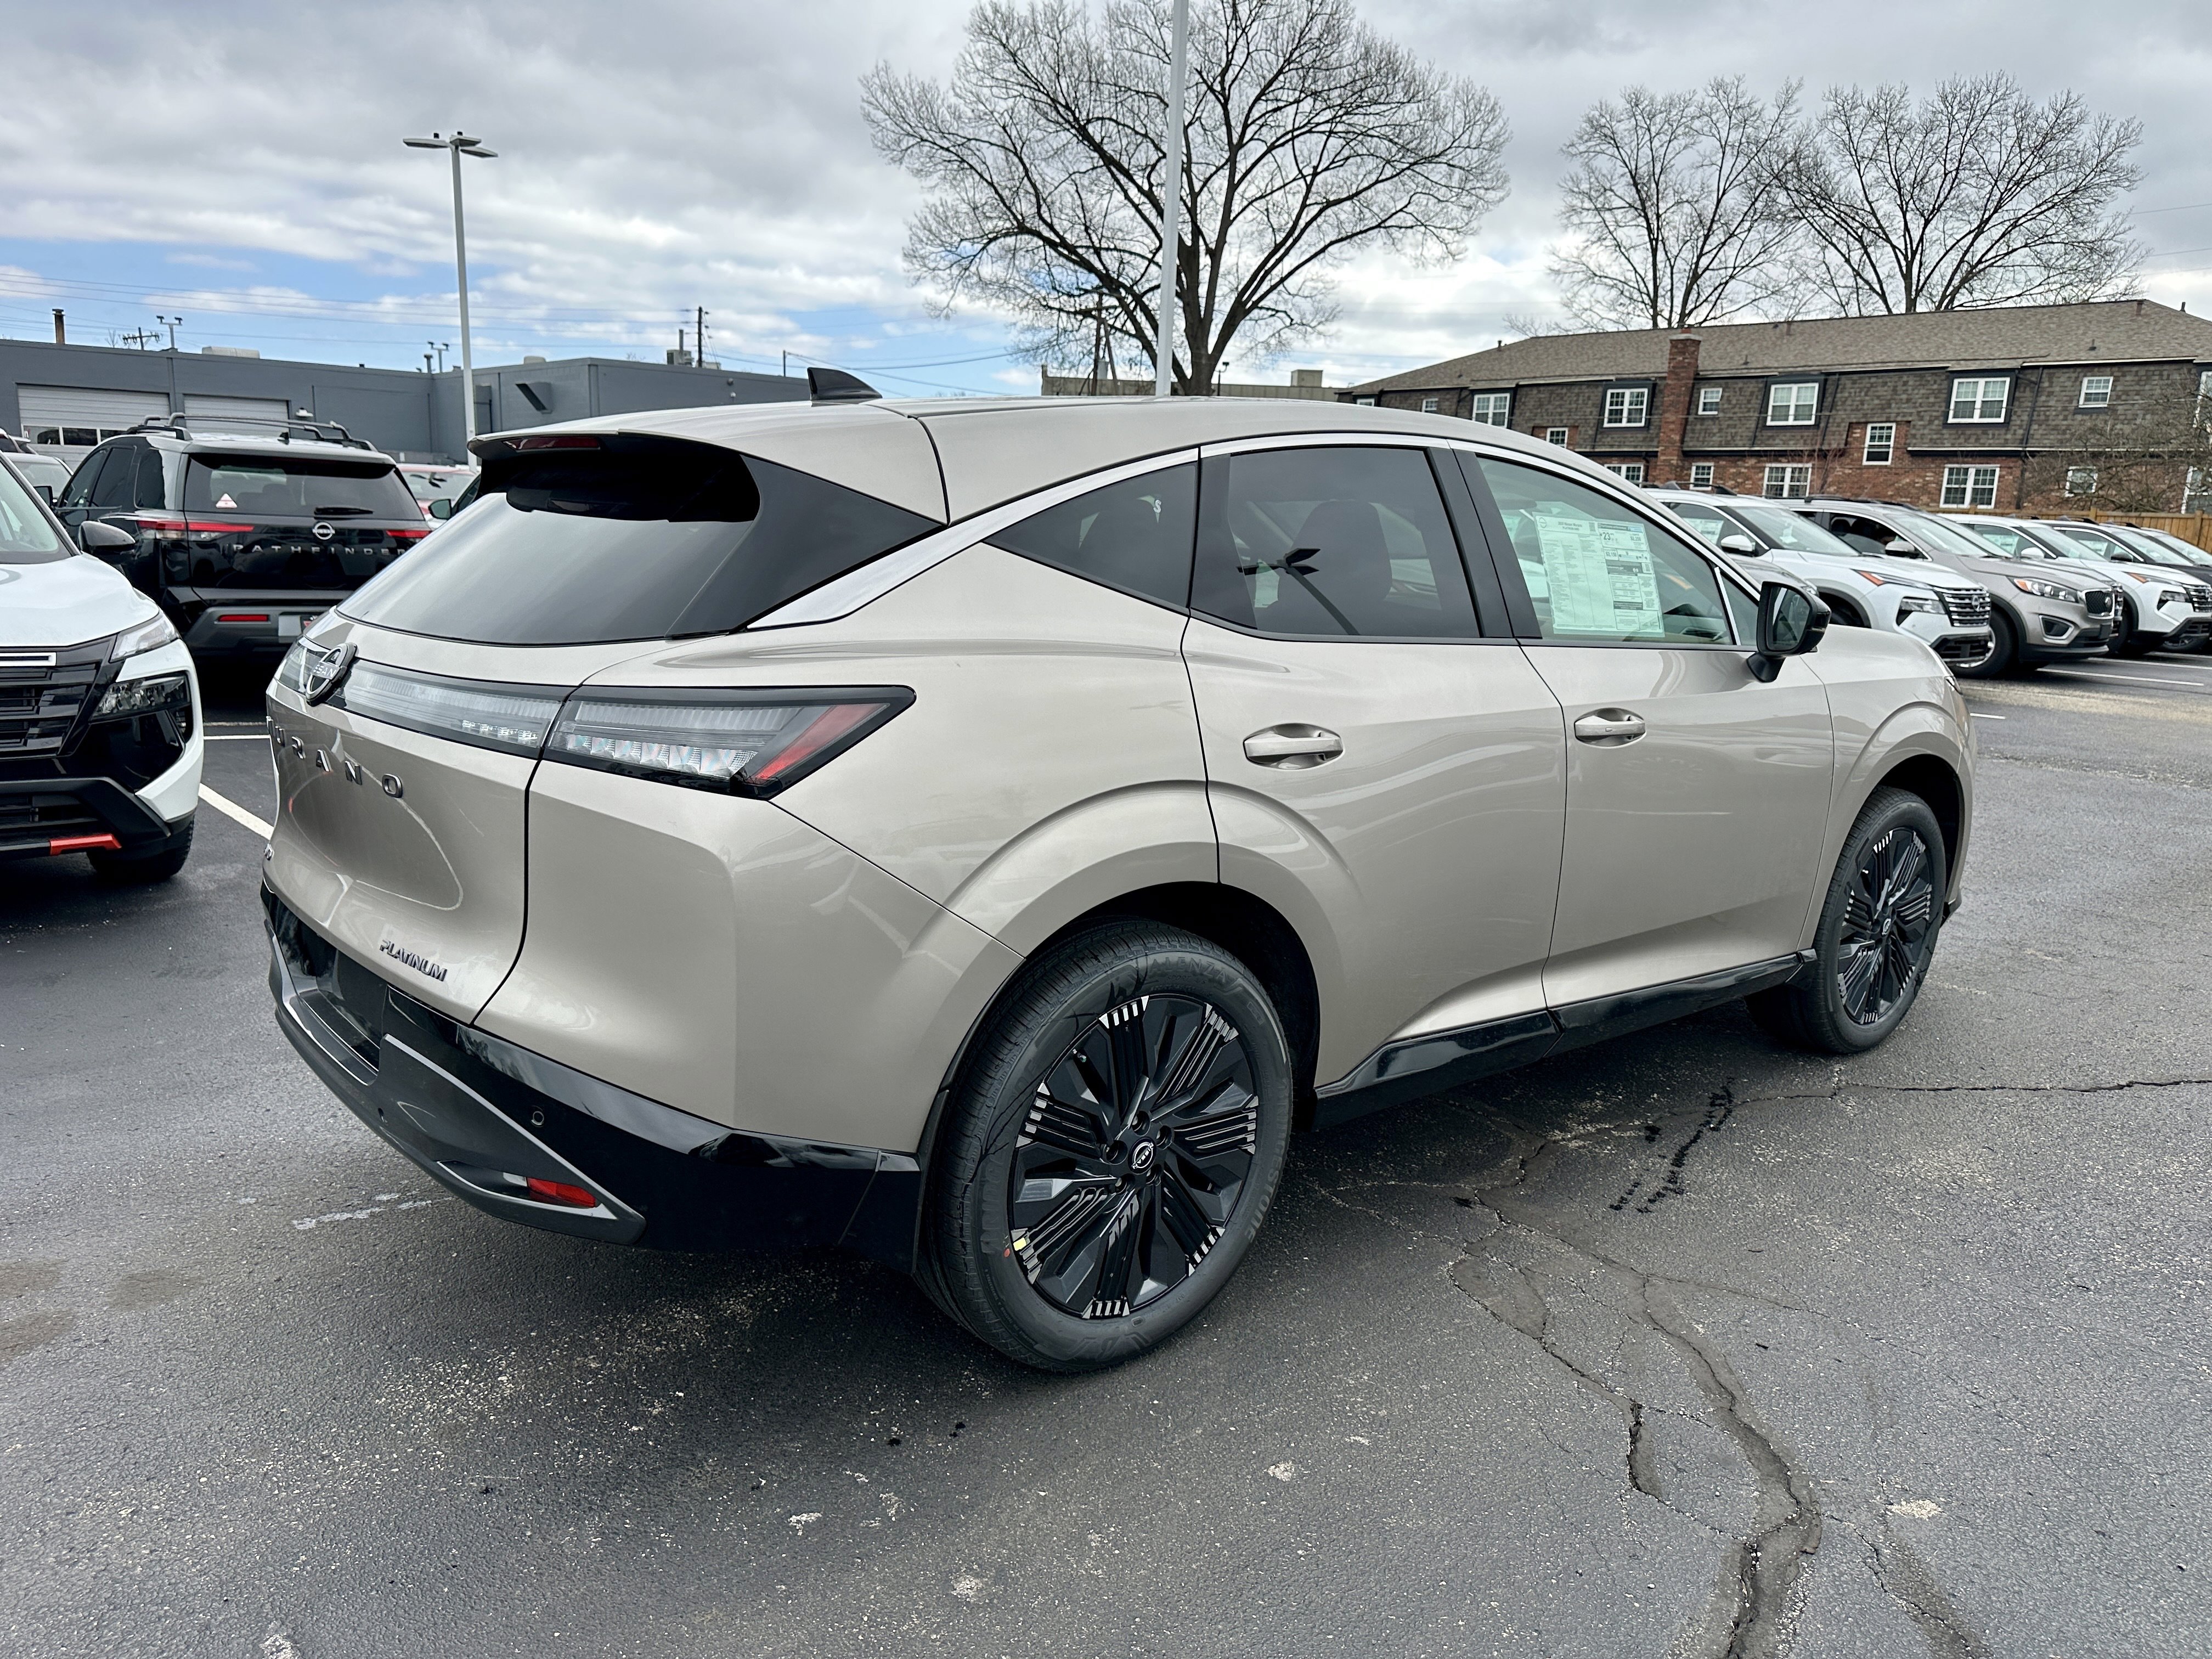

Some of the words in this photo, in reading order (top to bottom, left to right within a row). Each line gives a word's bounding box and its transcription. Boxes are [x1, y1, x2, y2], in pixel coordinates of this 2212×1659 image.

[1602, 532, 1611, 540] 23
[233, 544, 407, 555] PATHFINDER
[380, 939, 448, 981] PLATINUM
[1151, 956, 1229, 983] ALENZA
